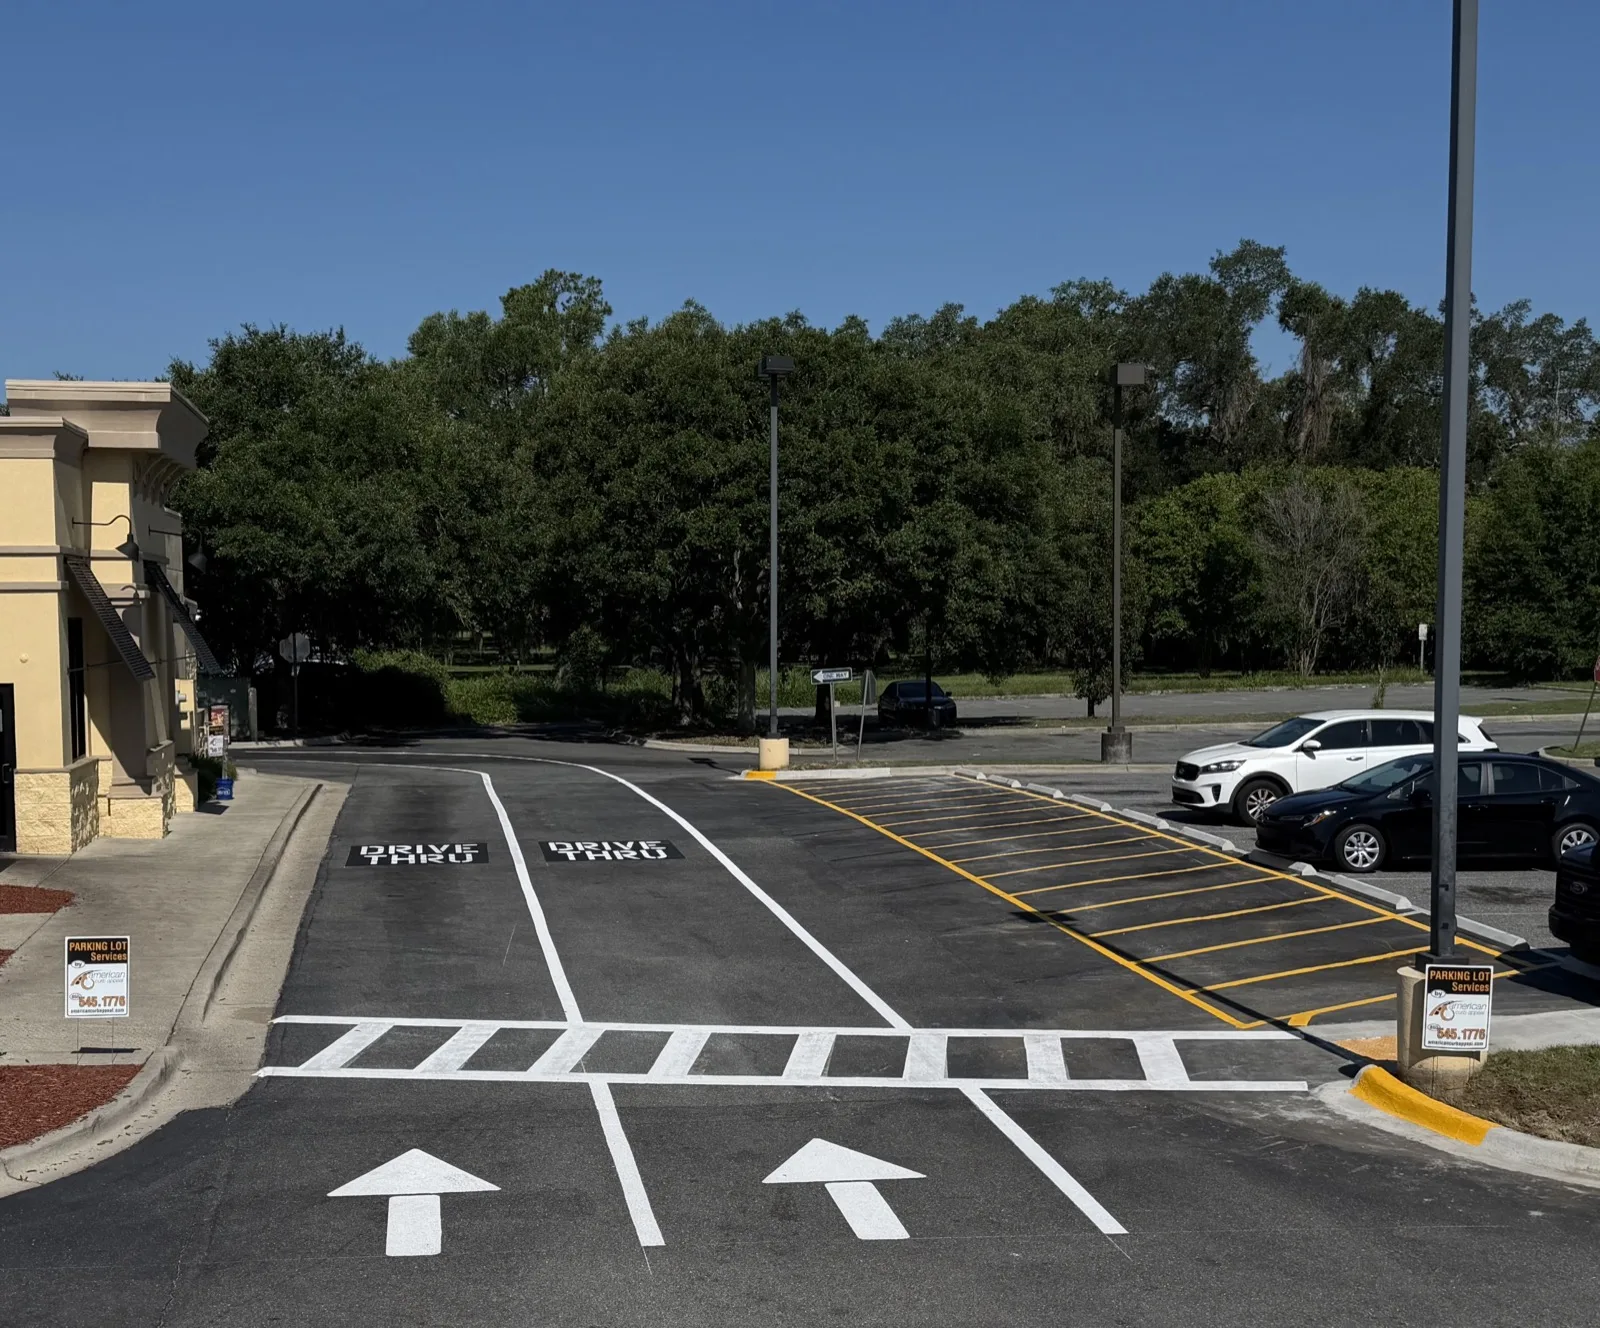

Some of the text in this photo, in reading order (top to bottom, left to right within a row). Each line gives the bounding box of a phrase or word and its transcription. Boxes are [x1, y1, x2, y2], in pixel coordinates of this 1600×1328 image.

[360, 843, 479, 855] DRIVE
[548, 840, 666, 851] DRIVE
[363, 854, 473, 865] THRU
[558, 850, 668, 861] THRU
[69, 941, 127, 952] PARKING LOT
[90, 951, 127, 961] Services
[1429, 970, 1490, 981] PARKING LOT
[1451, 981, 1490, 992] Services
